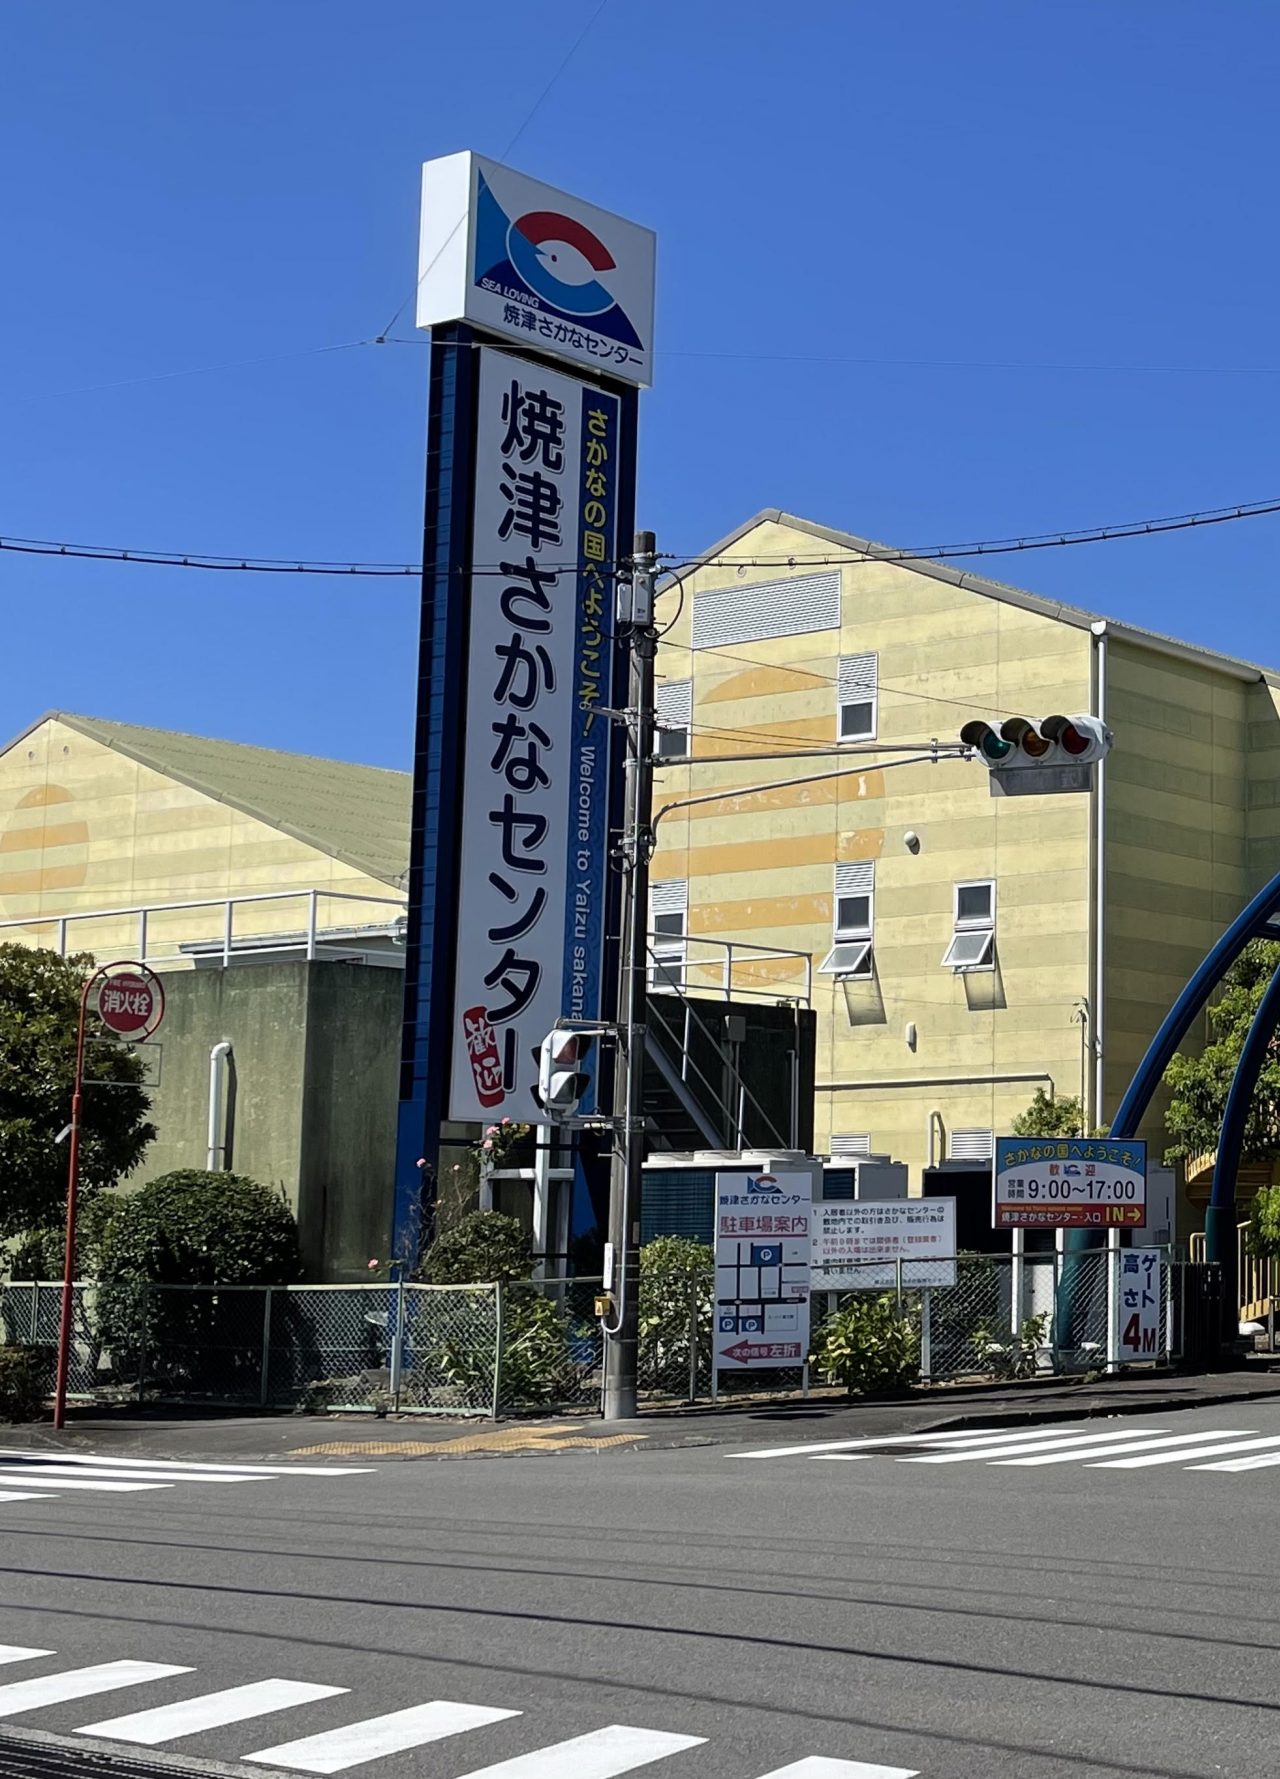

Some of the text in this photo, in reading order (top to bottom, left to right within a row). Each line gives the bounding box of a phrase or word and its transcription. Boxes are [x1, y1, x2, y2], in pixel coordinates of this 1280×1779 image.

[480, 277, 540, 309] SEA LOVING
[503, 303, 644, 366] 焼津さかなセンター
[484, 378, 564, 1092] 焼津さかなセンター
[571, 745, 596, 1021] Welcome to Yaizu sakana
[103, 989, 150, 1016] 消火栓
[1008, 1179, 1024, 1188] 営業
[1008, 1189, 1024, 1198] 時間
[719, 1195, 811, 1206] 焼津さかなセンター
[1106, 1206, 1124, 1222] IN
[720, 1216, 808, 1233] 駐車場案内
[1123, 1253, 1139, 1308] 高さ
[1142, 1254, 1156, 1308] ゲート
[769, 1344, 797, 1357] 左折
